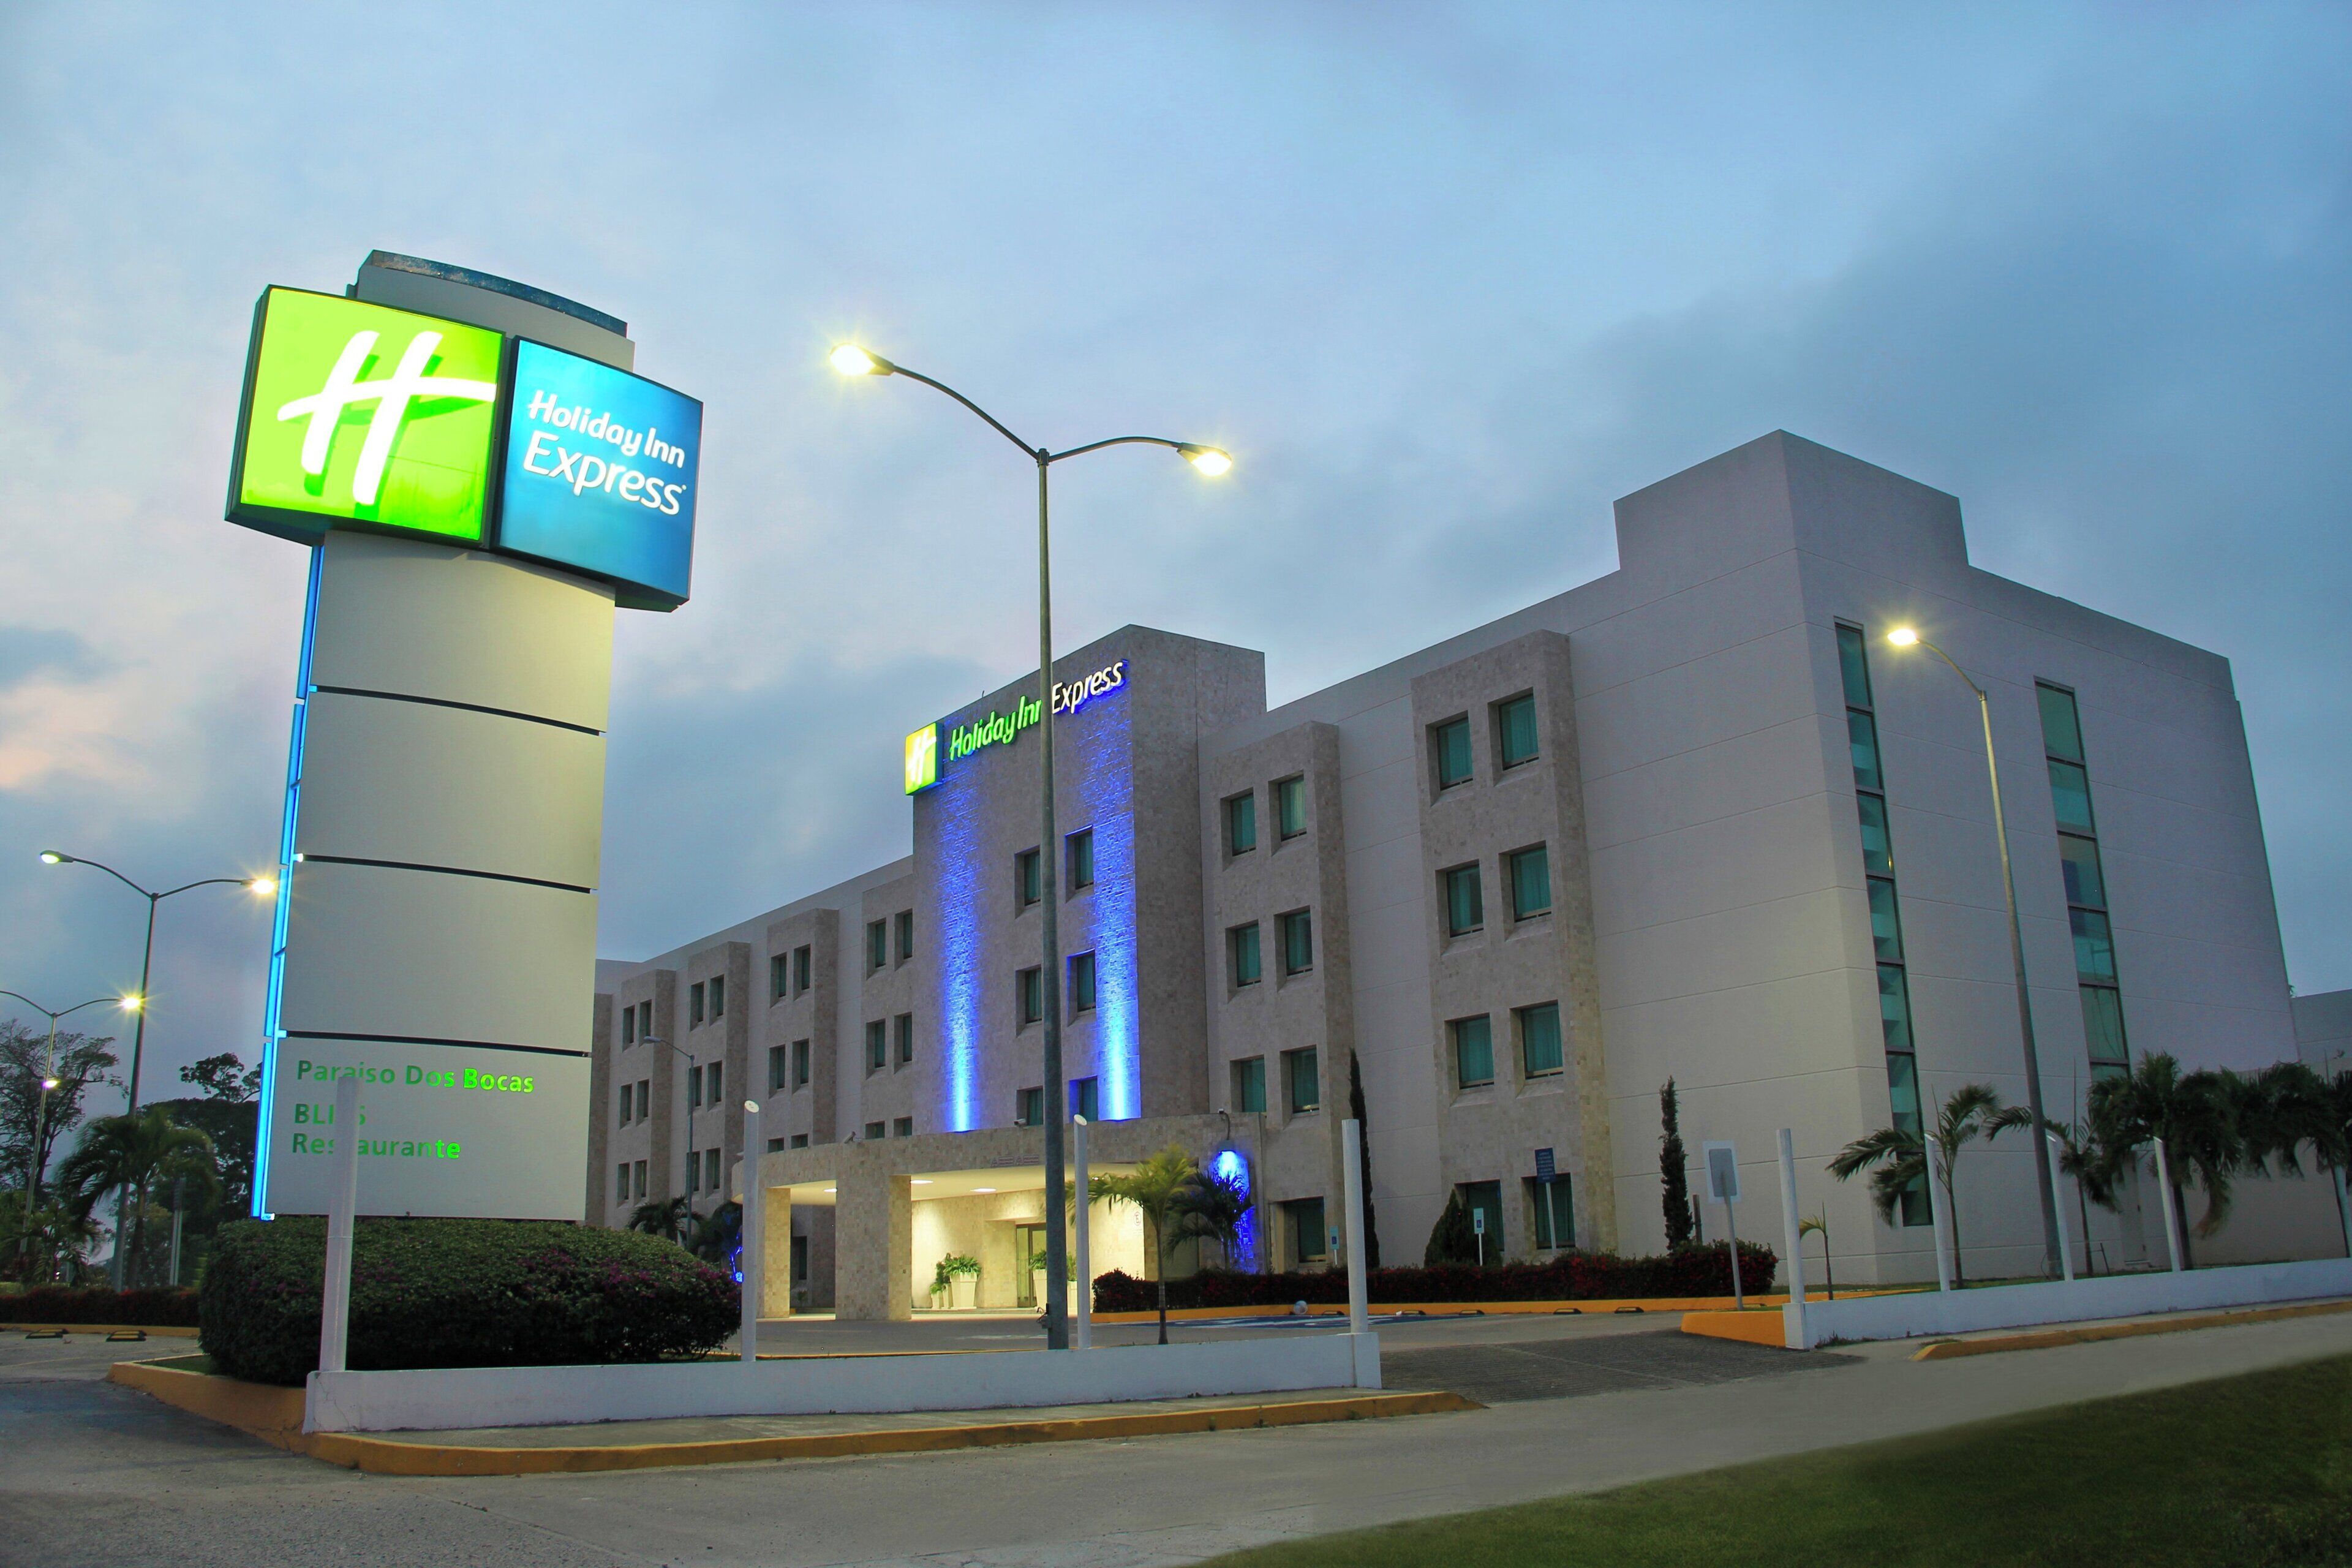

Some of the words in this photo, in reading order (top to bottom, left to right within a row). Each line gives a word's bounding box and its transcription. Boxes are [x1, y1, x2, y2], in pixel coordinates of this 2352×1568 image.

[527, 389, 643, 457] Holiday
[644, 427, 685, 469] Inn
[522, 429, 683, 516] Express
[949, 710, 1017, 761] Holiday
[1051, 661, 1123, 714] Express
[297, 1060, 396, 1084] Paraiso
[405, 1065, 456, 1088] Dos
[463, 1068, 535, 1093] Bocas
[295, 1103, 367, 1125] BLIS
[292, 1133, 461, 1159] Resaurante
